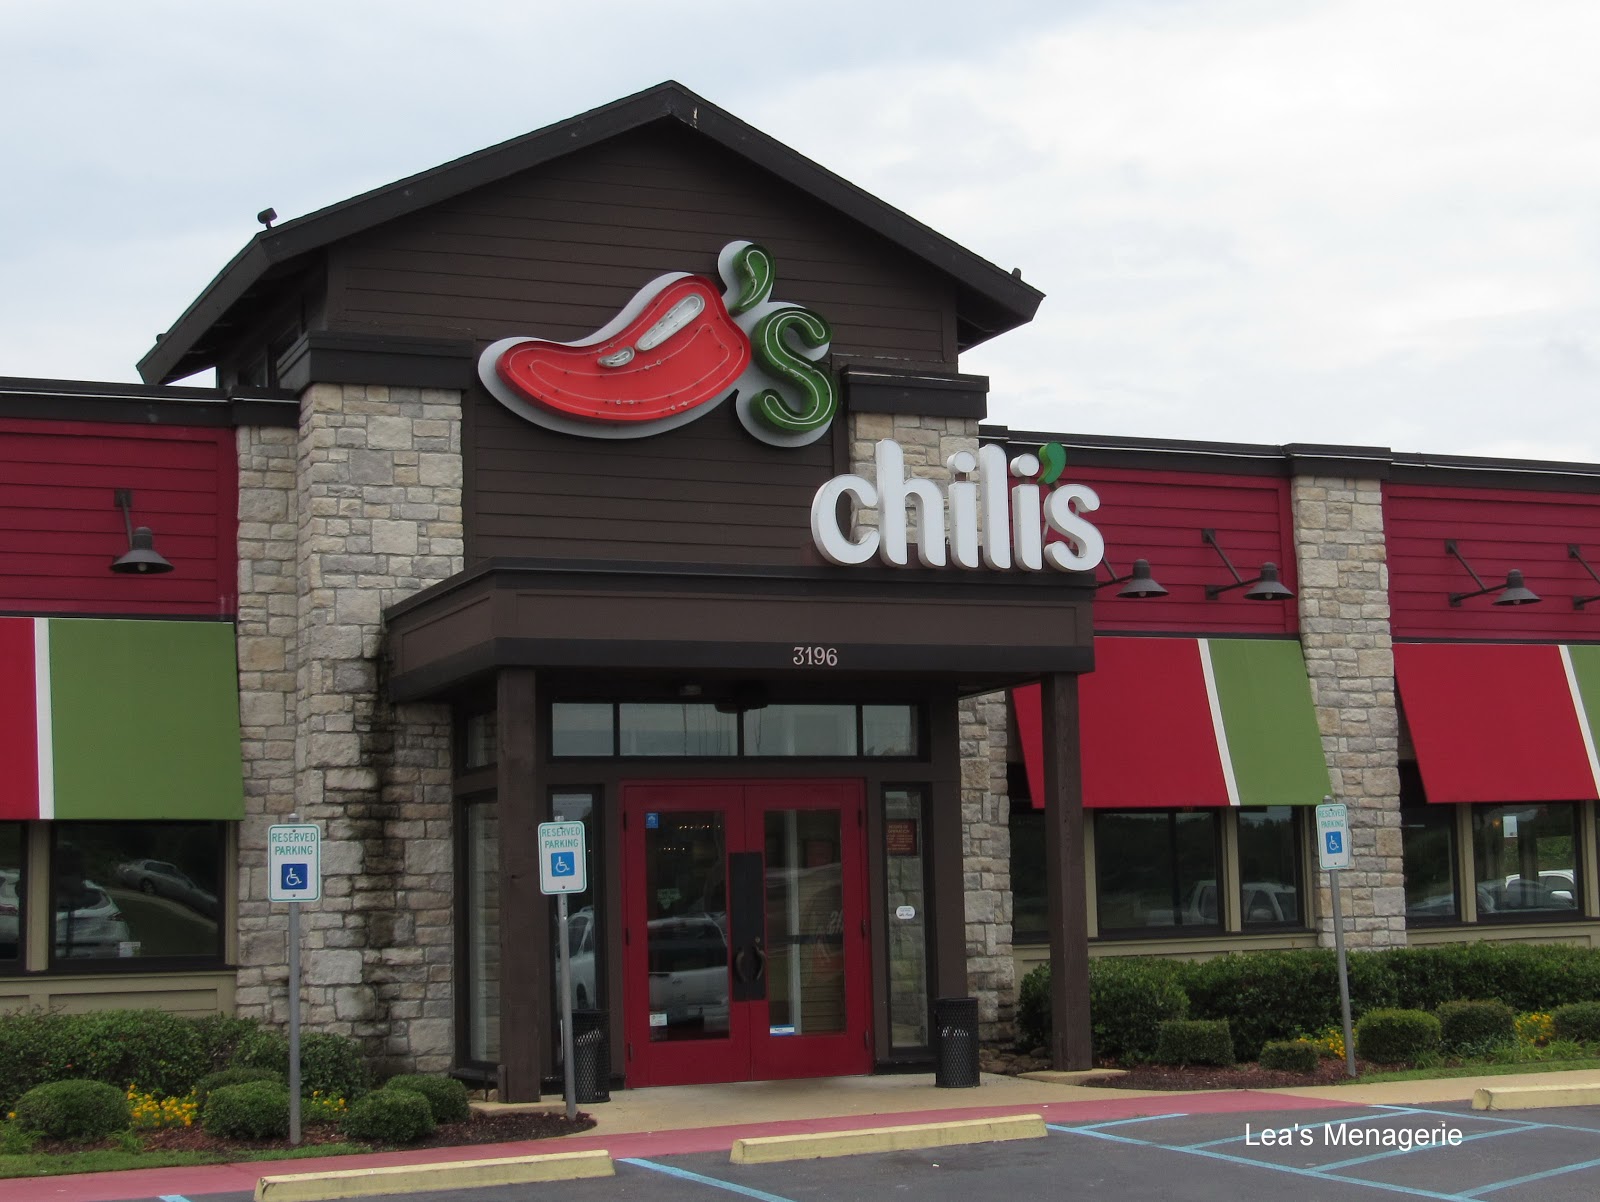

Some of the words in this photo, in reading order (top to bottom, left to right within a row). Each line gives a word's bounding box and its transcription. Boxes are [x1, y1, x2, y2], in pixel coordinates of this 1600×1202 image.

[810, 440, 1107, 572] chili's
[792, 646, 838, 667] 3196
[1318, 809, 1345, 818] RESERVED
[1320, 819, 1344, 828] PARKING
[541, 826, 581, 837] RESERVED
[272, 833, 316, 842] RESERVED
[545, 839, 579, 848] PARKING
[275, 846, 313, 855] PARKING
